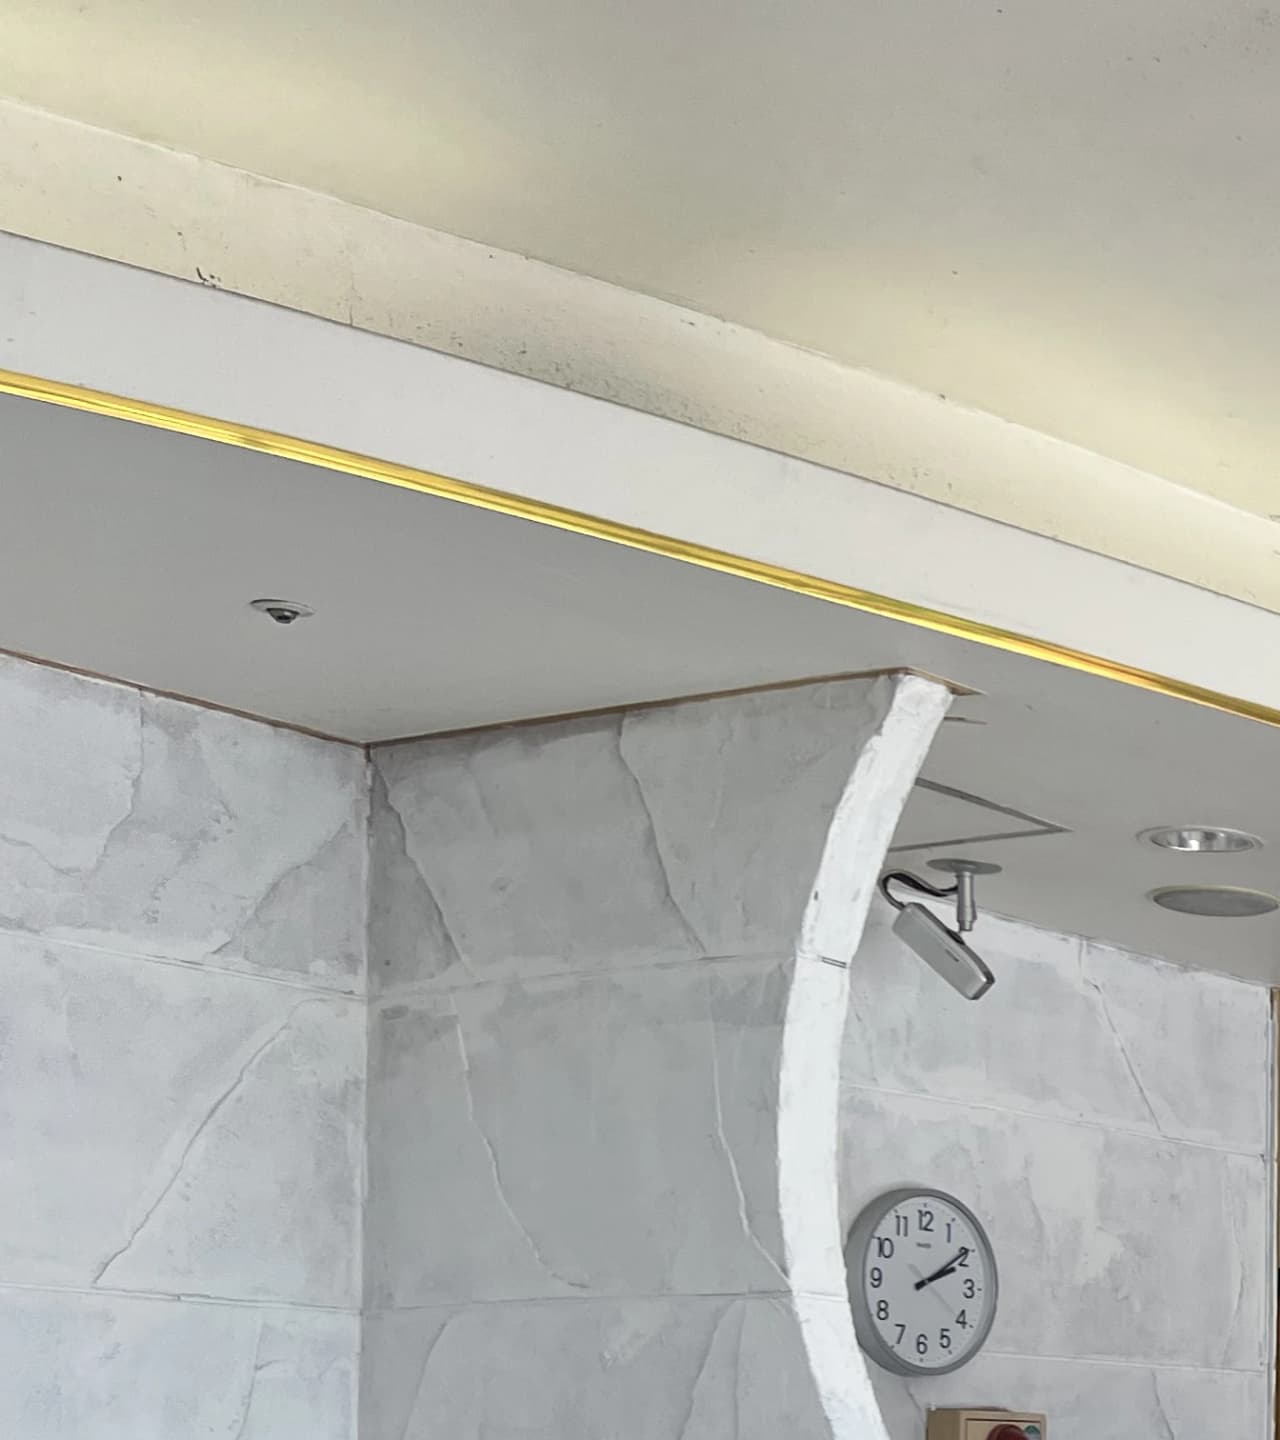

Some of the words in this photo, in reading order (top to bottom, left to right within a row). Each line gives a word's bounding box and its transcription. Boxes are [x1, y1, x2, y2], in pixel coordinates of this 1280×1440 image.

[895, 1214, 908, 1237] 11
[918, 1209, 934, 1232] 12
[946, 1222, 951, 1243] 1
[876, 1236, 894, 1259] 10
[958, 1246, 969, 1267] 2
[870, 1267, 883, 1288] 9
[963, 1278, 975, 1299] 3
[876, 1299, 889, 1320] 8
[955, 1309, 968, 1329] 4
[894, 1323, 906, 1344] 7
[916, 1333, 928, 1354] 6
[939, 1328, 951, 1348] 5
